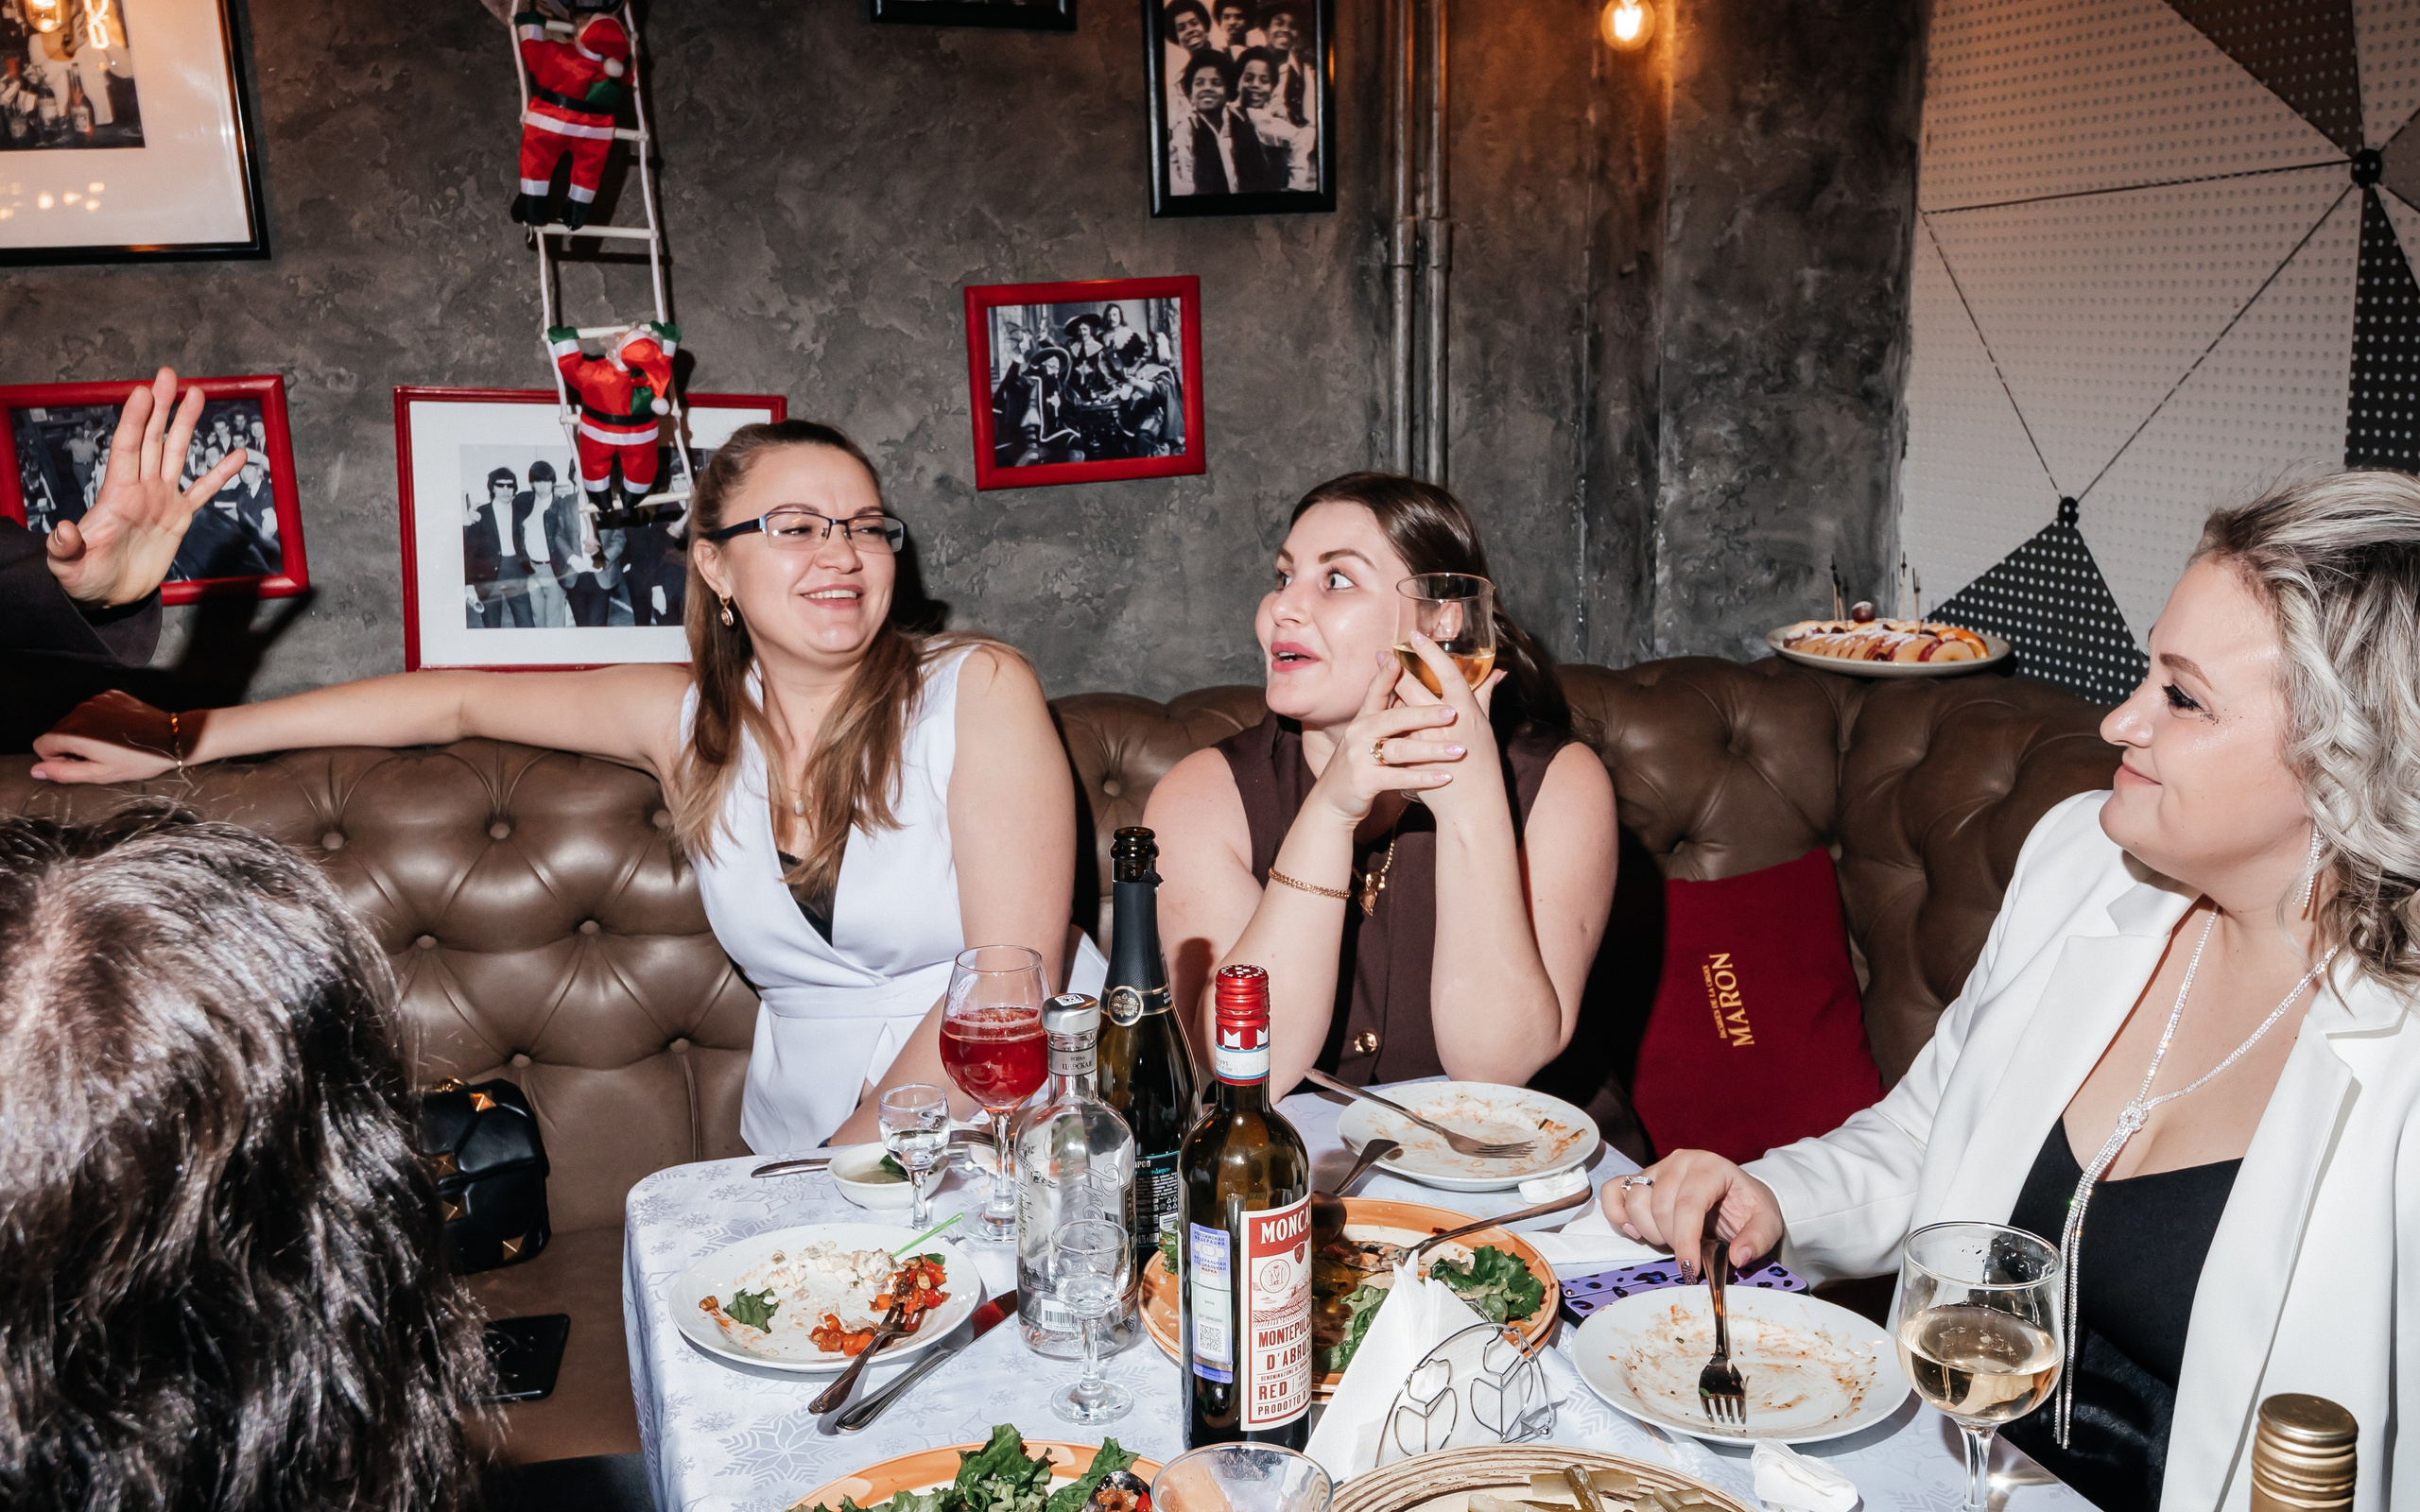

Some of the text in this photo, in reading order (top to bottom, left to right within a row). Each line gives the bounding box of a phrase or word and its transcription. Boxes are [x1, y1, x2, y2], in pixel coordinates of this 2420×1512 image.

[1707, 988, 1716, 998] LA
[1708, 953, 1755, 1047] MARON
[1062, 1059, 1093, 1071] ЦАРСКАЯ
[1194, 1230, 1225, 1242] РОССИЙСКАЯ
[1194, 1234, 1225, 1246] ФЕДЕРАЦИЯ
[1193, 1254, 1227, 1266] ФЕДЕРАЛЬНАЯ
[1193, 1259, 1227, 1271] СПЕЦИАЛЬНАЯ
[1260, 1367, 1294, 1382] DENOMINAZIONE
[1258, 1381, 1288, 1400] RED
[1257, 1394, 1301, 1416] PRODOTTO
